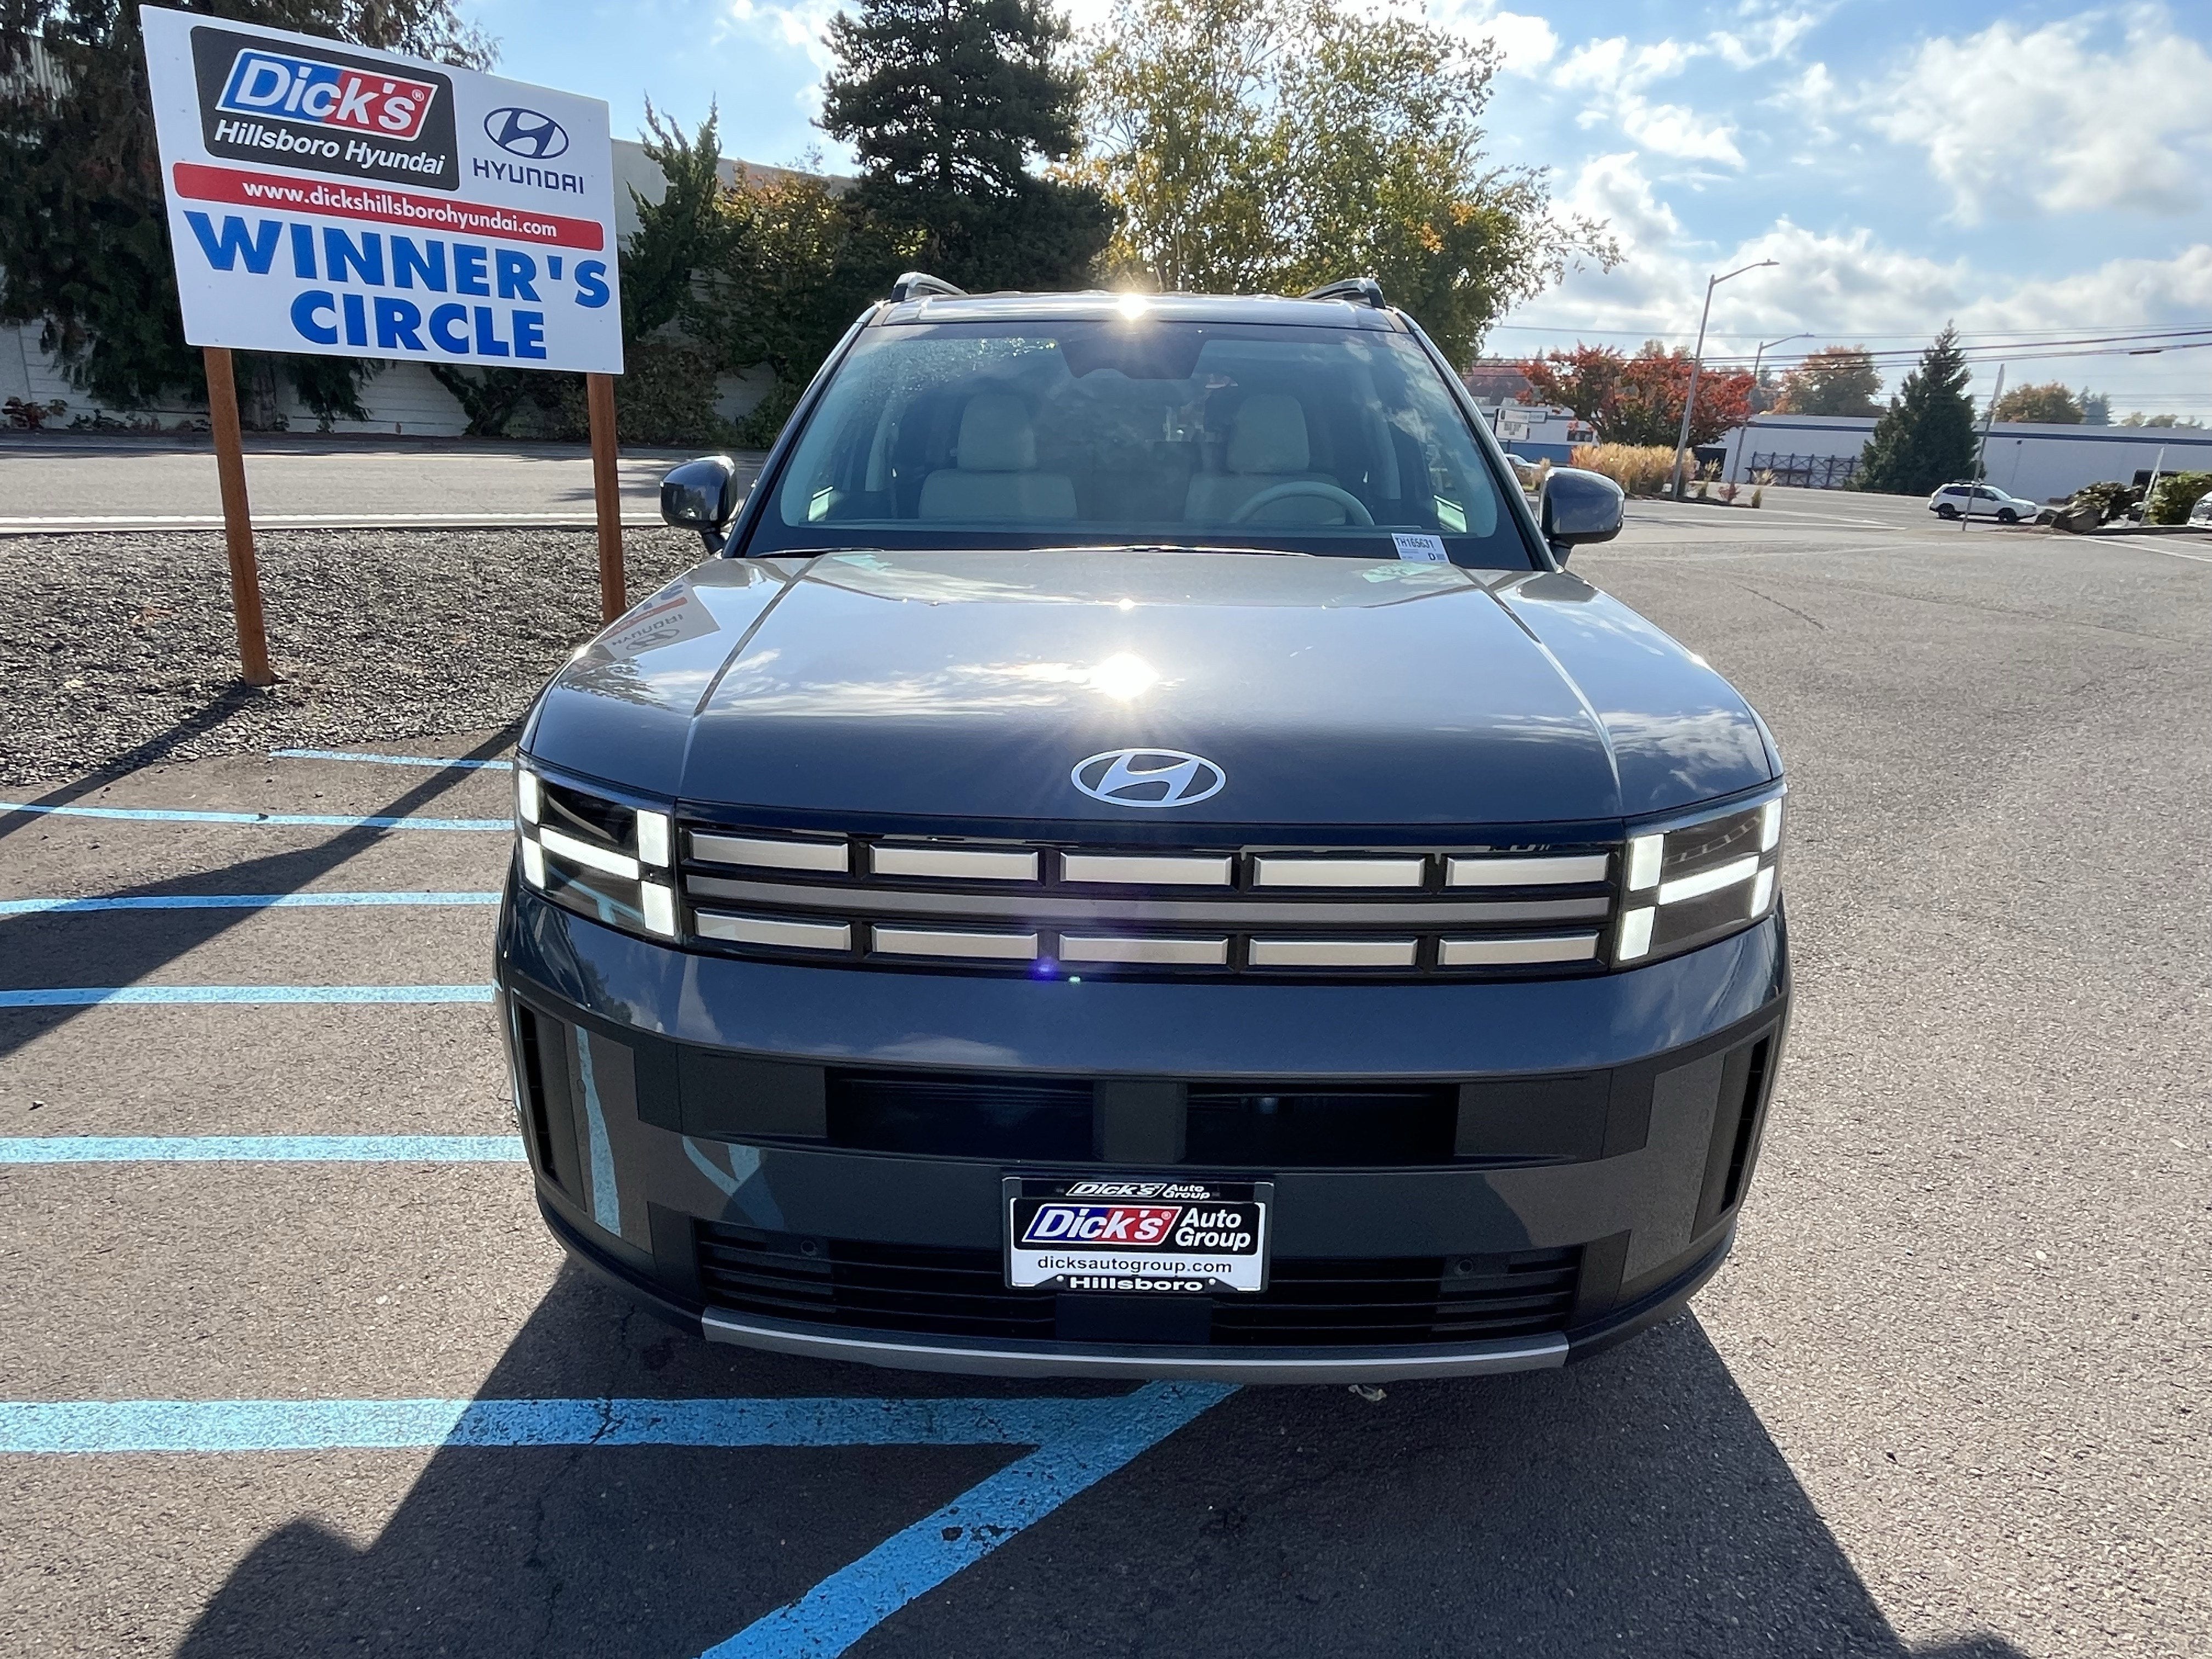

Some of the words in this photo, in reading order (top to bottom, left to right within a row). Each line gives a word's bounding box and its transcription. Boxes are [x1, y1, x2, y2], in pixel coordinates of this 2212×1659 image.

[235, 59, 416, 132] Dick's
[215, 119, 340, 159] Hillsboro
[346, 139, 446, 176] Hyundai
[473, 159, 584, 194] HYUNDAI
[242, 179, 557, 238] www.dickshillsborohyundai.com
[183, 210, 611, 308] WINNER'S
[290, 290, 547, 360] CIRCLE
[1163, 1191, 1210, 1200] Group
[1166, 1184, 1205, 1192] Auto
[1033, 1208, 1164, 1240] Dick's
[1180, 1207, 1242, 1228] Auto
[1175, 1229, 1251, 1251] Group
[1037, 1255, 1232, 1273] dicksautogroup.com
[1070, 1277, 1203, 1291] Hillsboro
